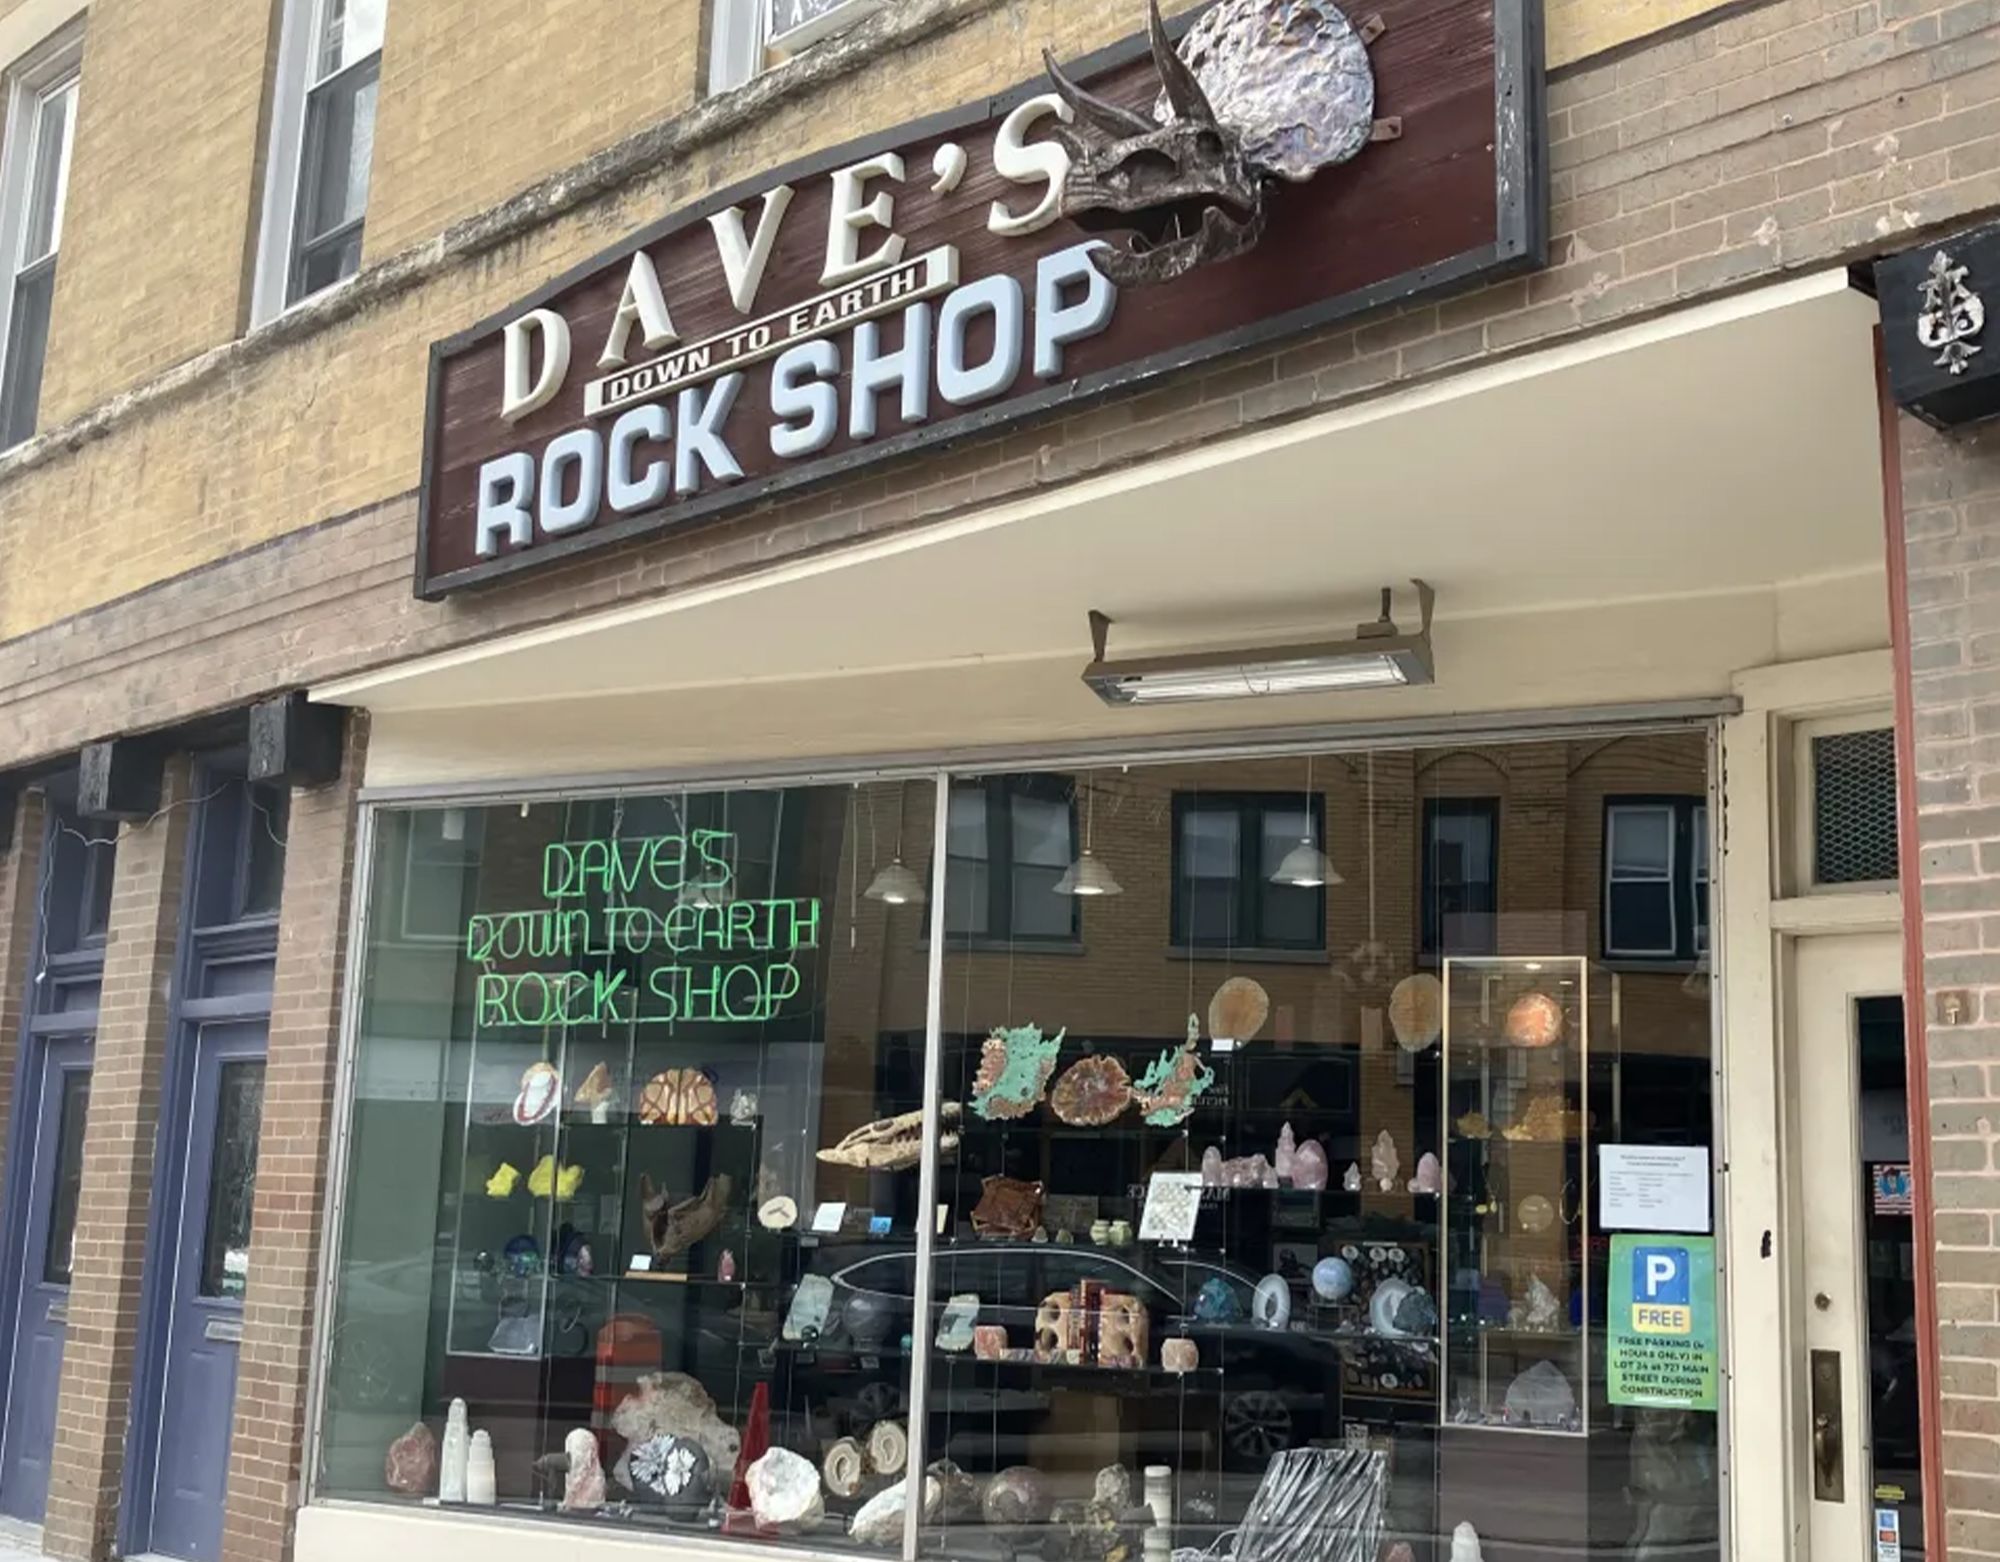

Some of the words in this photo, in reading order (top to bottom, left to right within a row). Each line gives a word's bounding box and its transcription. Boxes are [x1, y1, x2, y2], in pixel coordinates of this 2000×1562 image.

[500, 92, 1076, 421] DAVE'S
[610, 347, 711, 402] DOWN
[726, 325, 771, 358] TO
[788, 269, 918, 337] EARTH
[475, 373, 746, 559] ROCK
[769, 239, 1117, 460] SHOP
[603, 906, 652, 953] TO
[479, 968, 627, 1026] ROCK
[650, 963, 800, 1022] SHOP
[1646, 1254, 1676, 1296] P
[1638, 1308, 1684, 1327] FREE
[1618, 1336, 1642, 1346] FREE
[1645, 1337, 1691, 1349] PARKING
[1620, 1348, 1655, 1359] HOURS
[1613, 1360, 1633, 1370] LOT
[1682, 1364, 1709, 1374] MAIN
[1621, 1372, 1659, 1384] STREET
[1662, 1374, 1703, 1386] DURING
[1619, 1384, 1703, 1398] CONSTRUCTION
